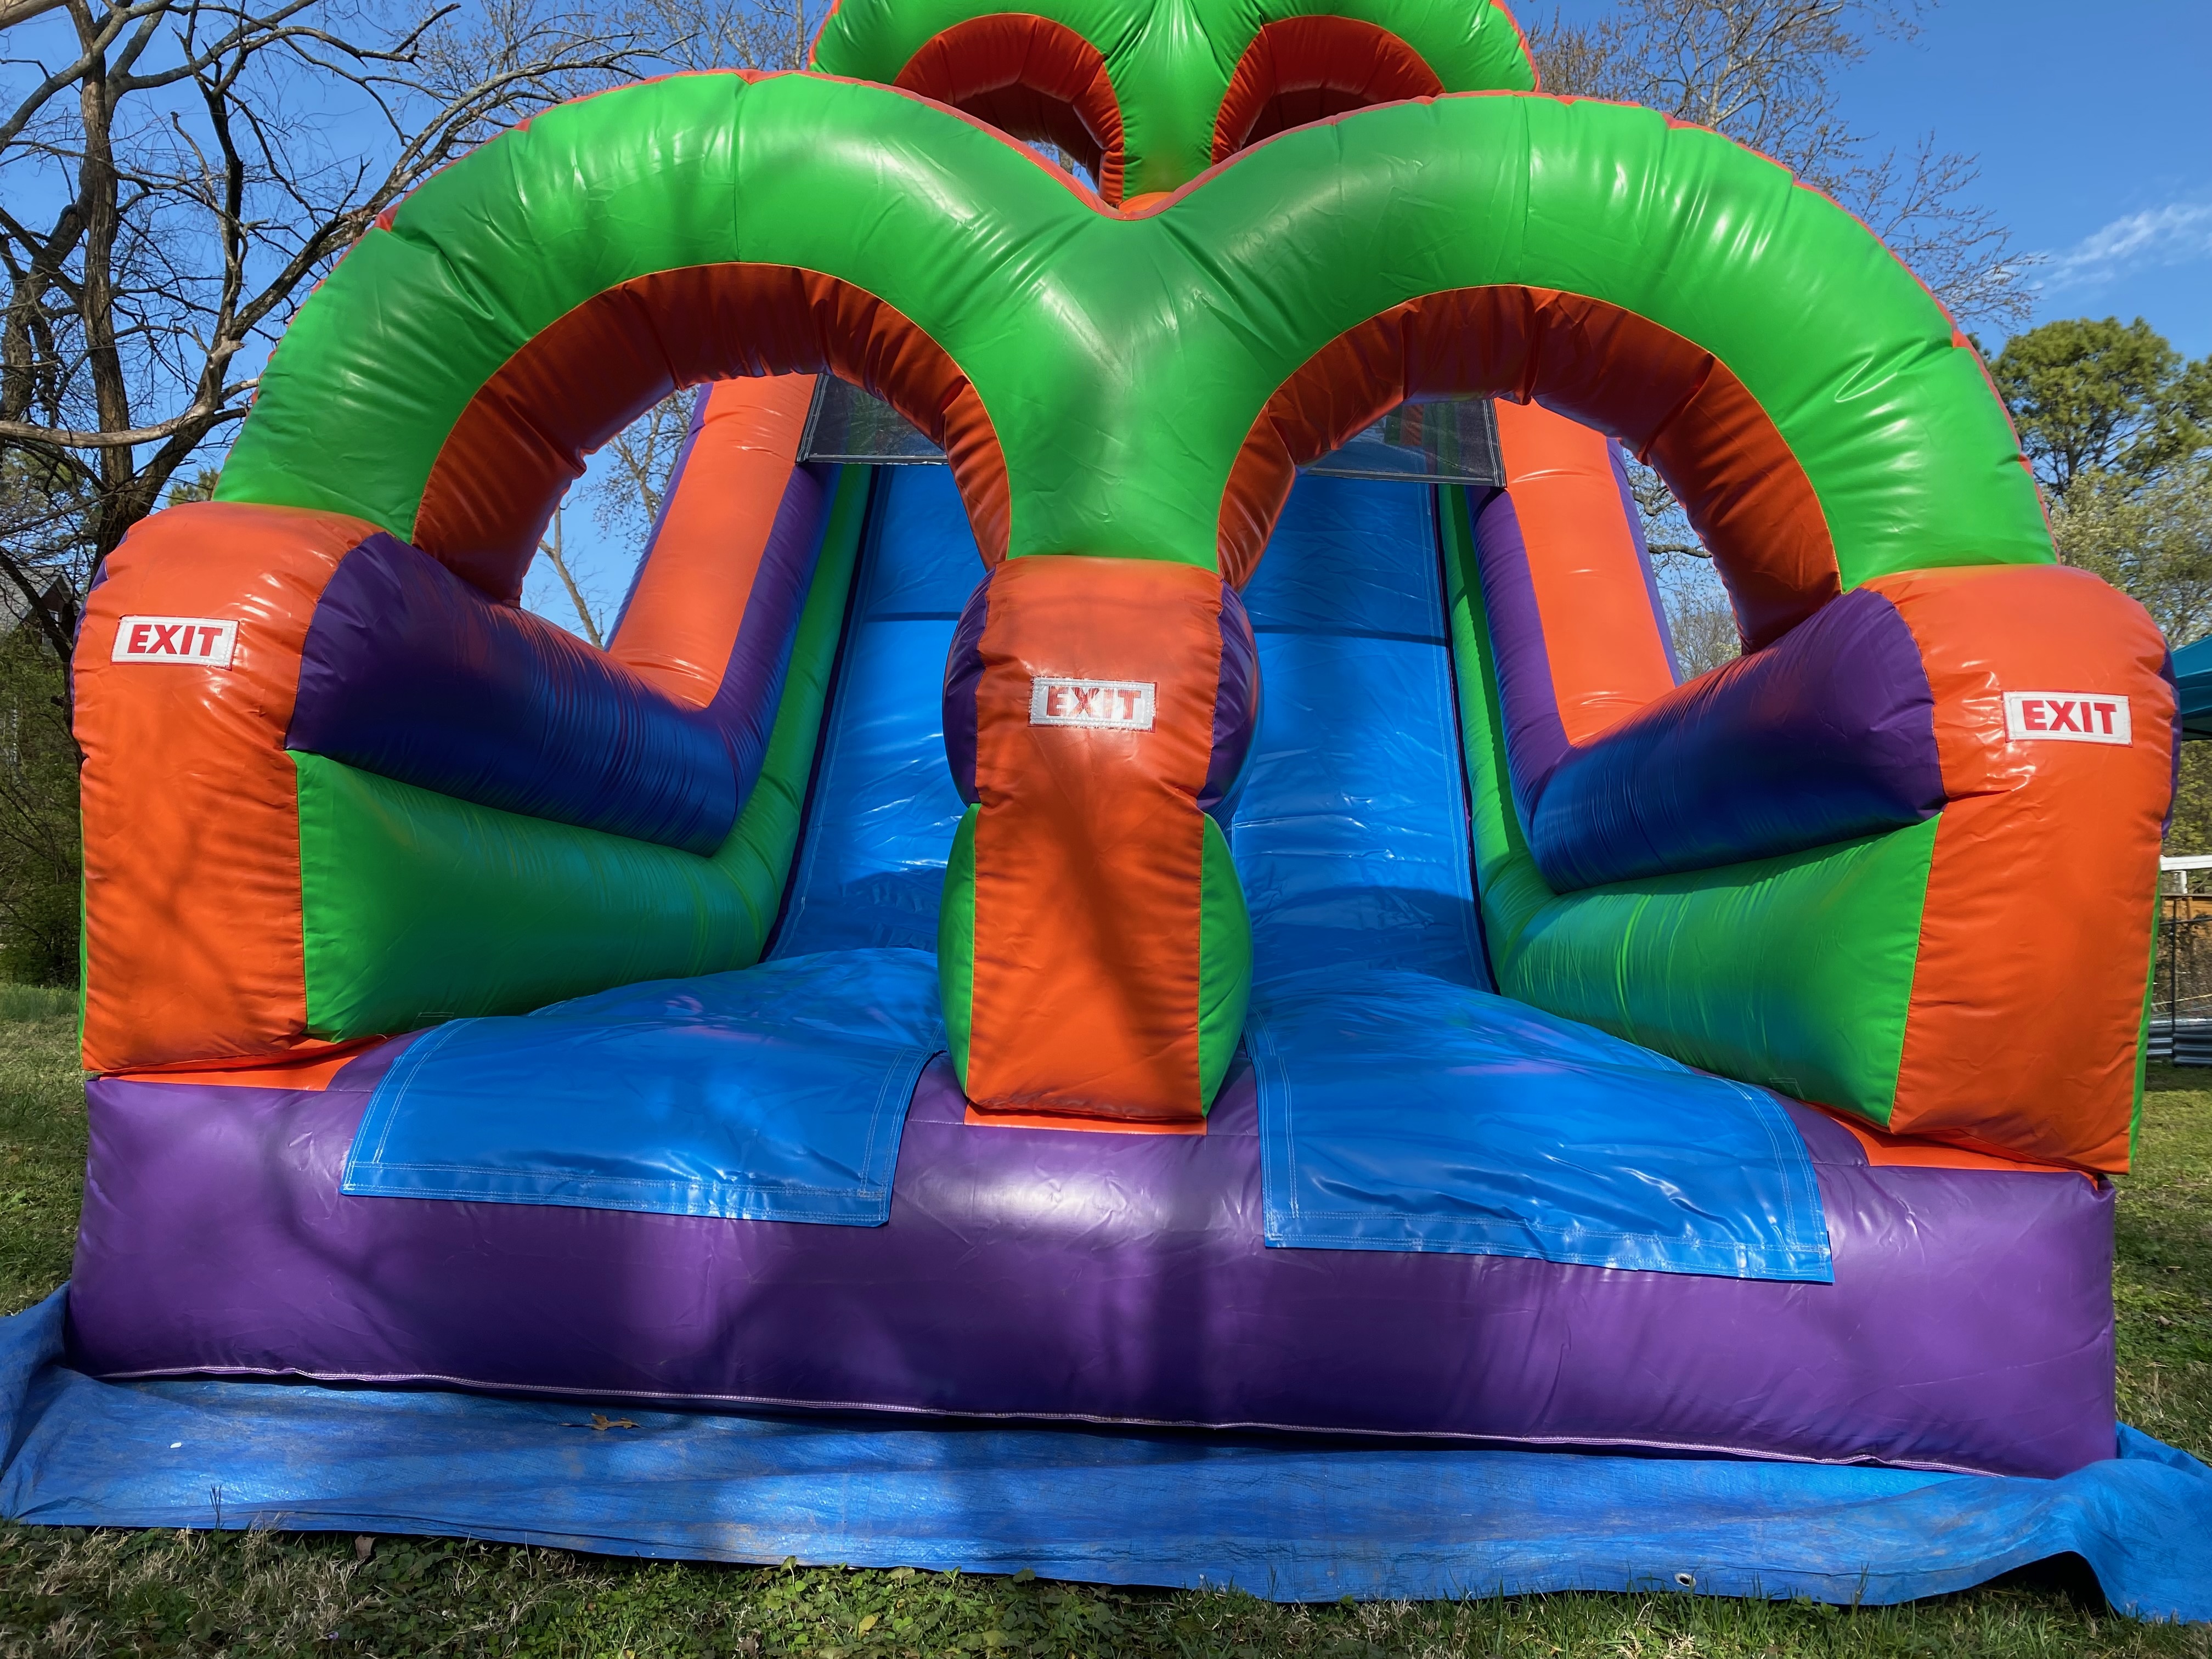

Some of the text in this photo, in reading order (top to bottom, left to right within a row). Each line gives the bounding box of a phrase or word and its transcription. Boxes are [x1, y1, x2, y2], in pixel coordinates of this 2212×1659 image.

[127, 624, 223, 657] EXIT
[1046, 685, 1142, 720] EXIT
[2022, 700, 2117, 734] EXIT
